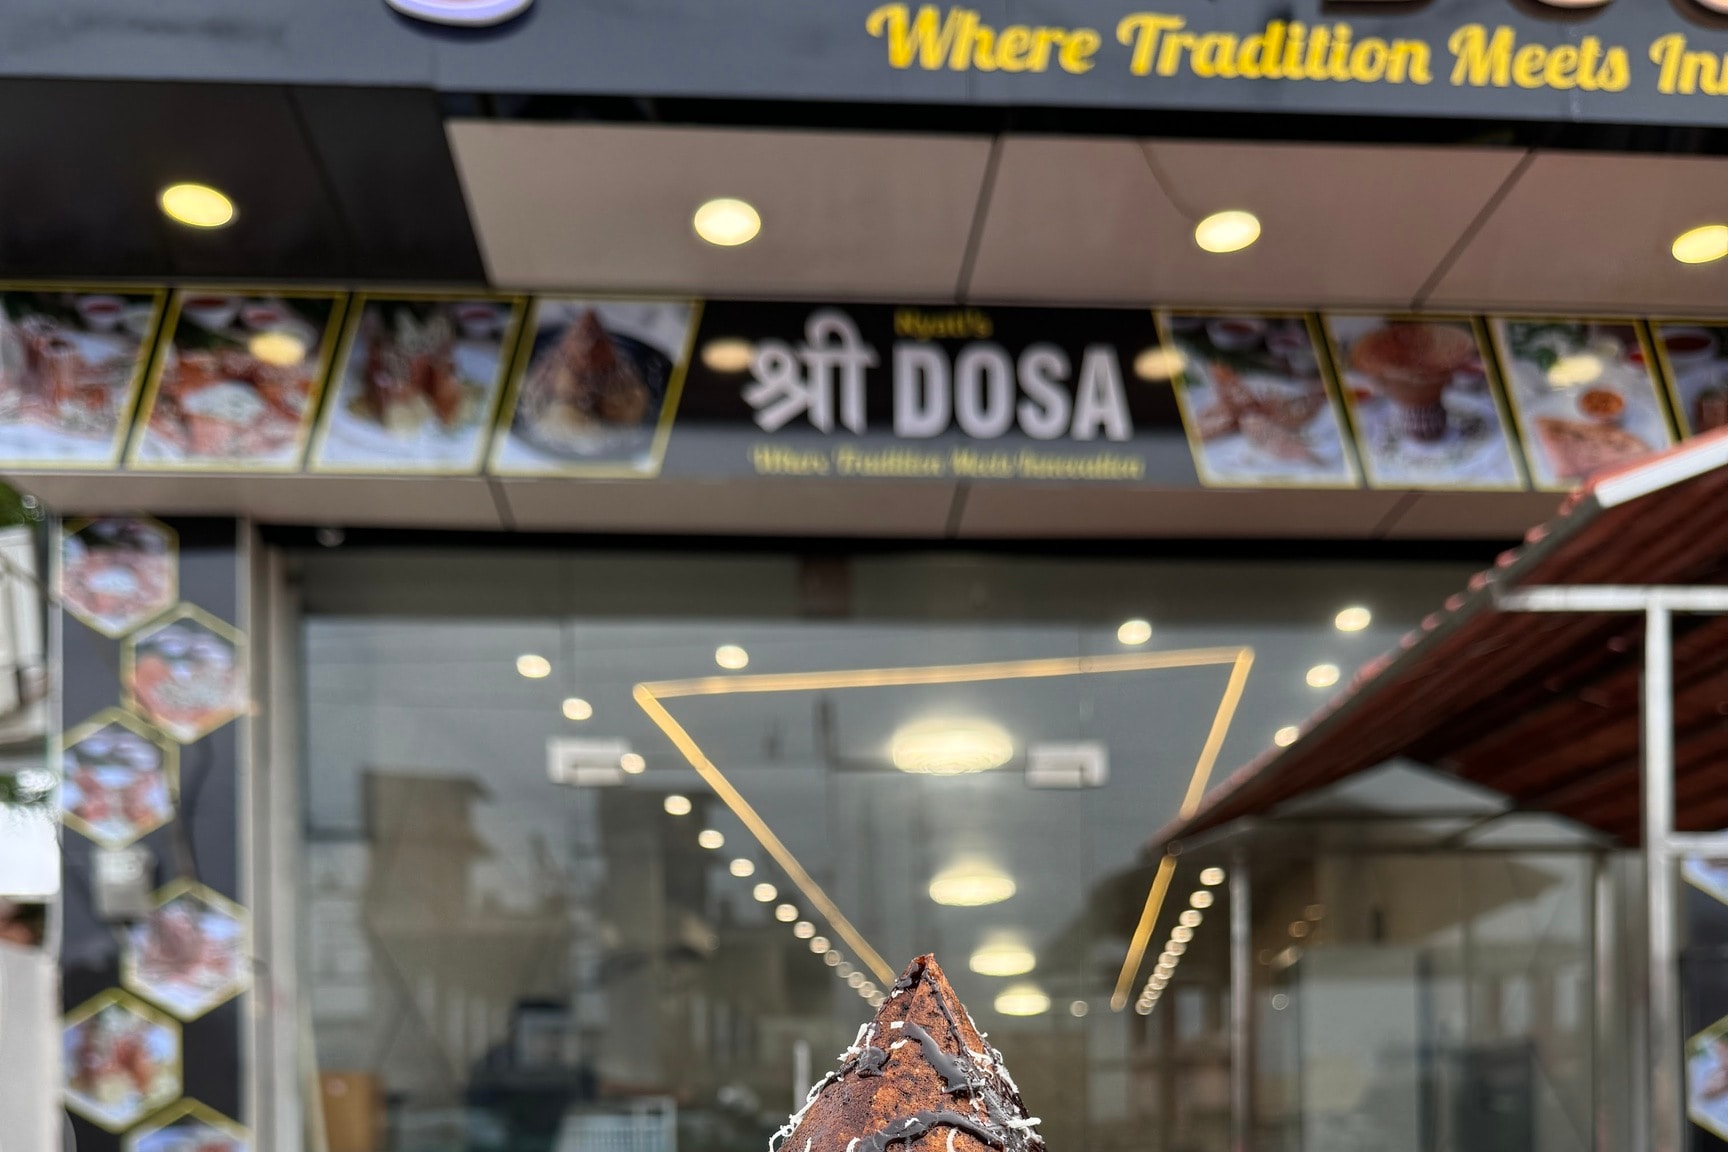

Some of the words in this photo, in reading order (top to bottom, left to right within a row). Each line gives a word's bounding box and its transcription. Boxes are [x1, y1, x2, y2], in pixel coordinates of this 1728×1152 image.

[866, 4, 1101, 74] Where
[1116, 13, 1433, 85] Tradition
[1448, 23, 1631, 93] Meets
[1649, 32, 1728, 96] In
[744, 311, 879, 433] श्री
[893, 341, 1133, 441] DOSA
